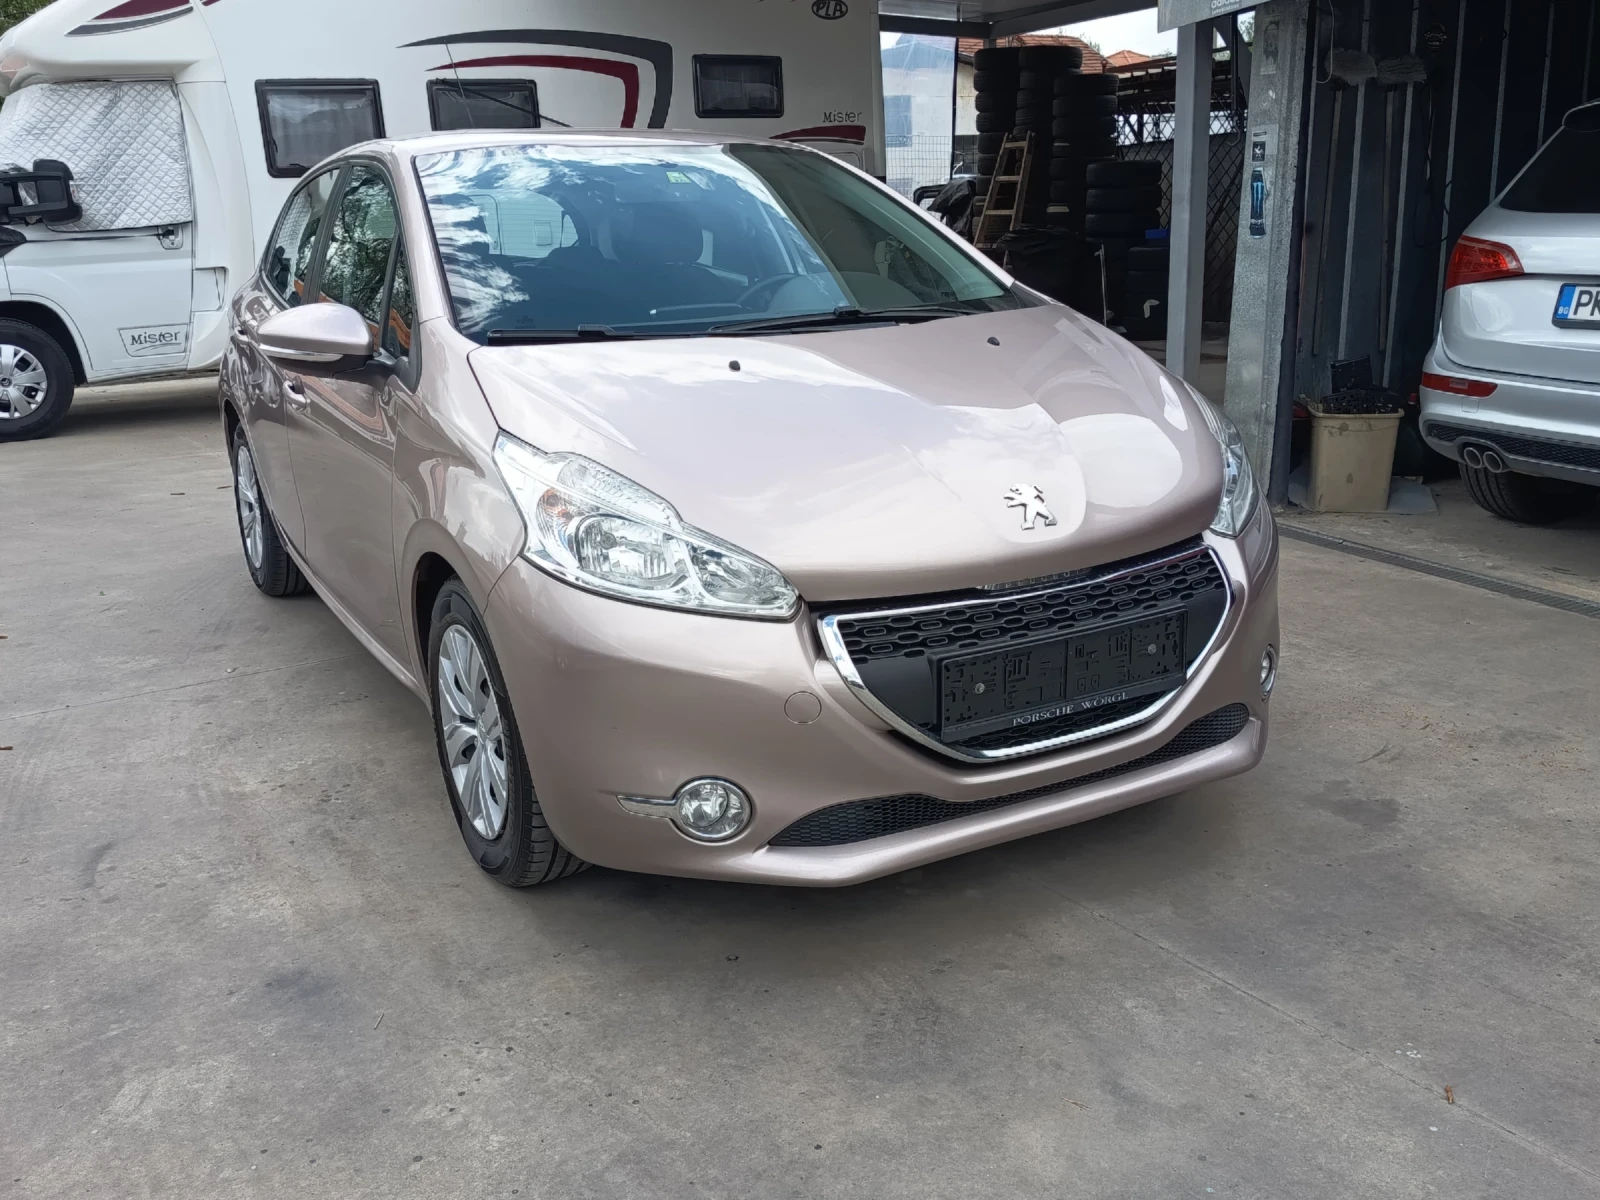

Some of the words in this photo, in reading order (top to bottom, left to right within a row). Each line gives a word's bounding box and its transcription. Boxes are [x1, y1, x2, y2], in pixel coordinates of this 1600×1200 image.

[815, 0, 845, 17] PLA
[822, 109, 862, 123] Mister
[1557, 306, 1569, 315] BG
[130, 331, 181, 346] Mister
[1012, 704, 1075, 727] PORSCHE
[1081, 691, 1129, 710] WÖRGL
